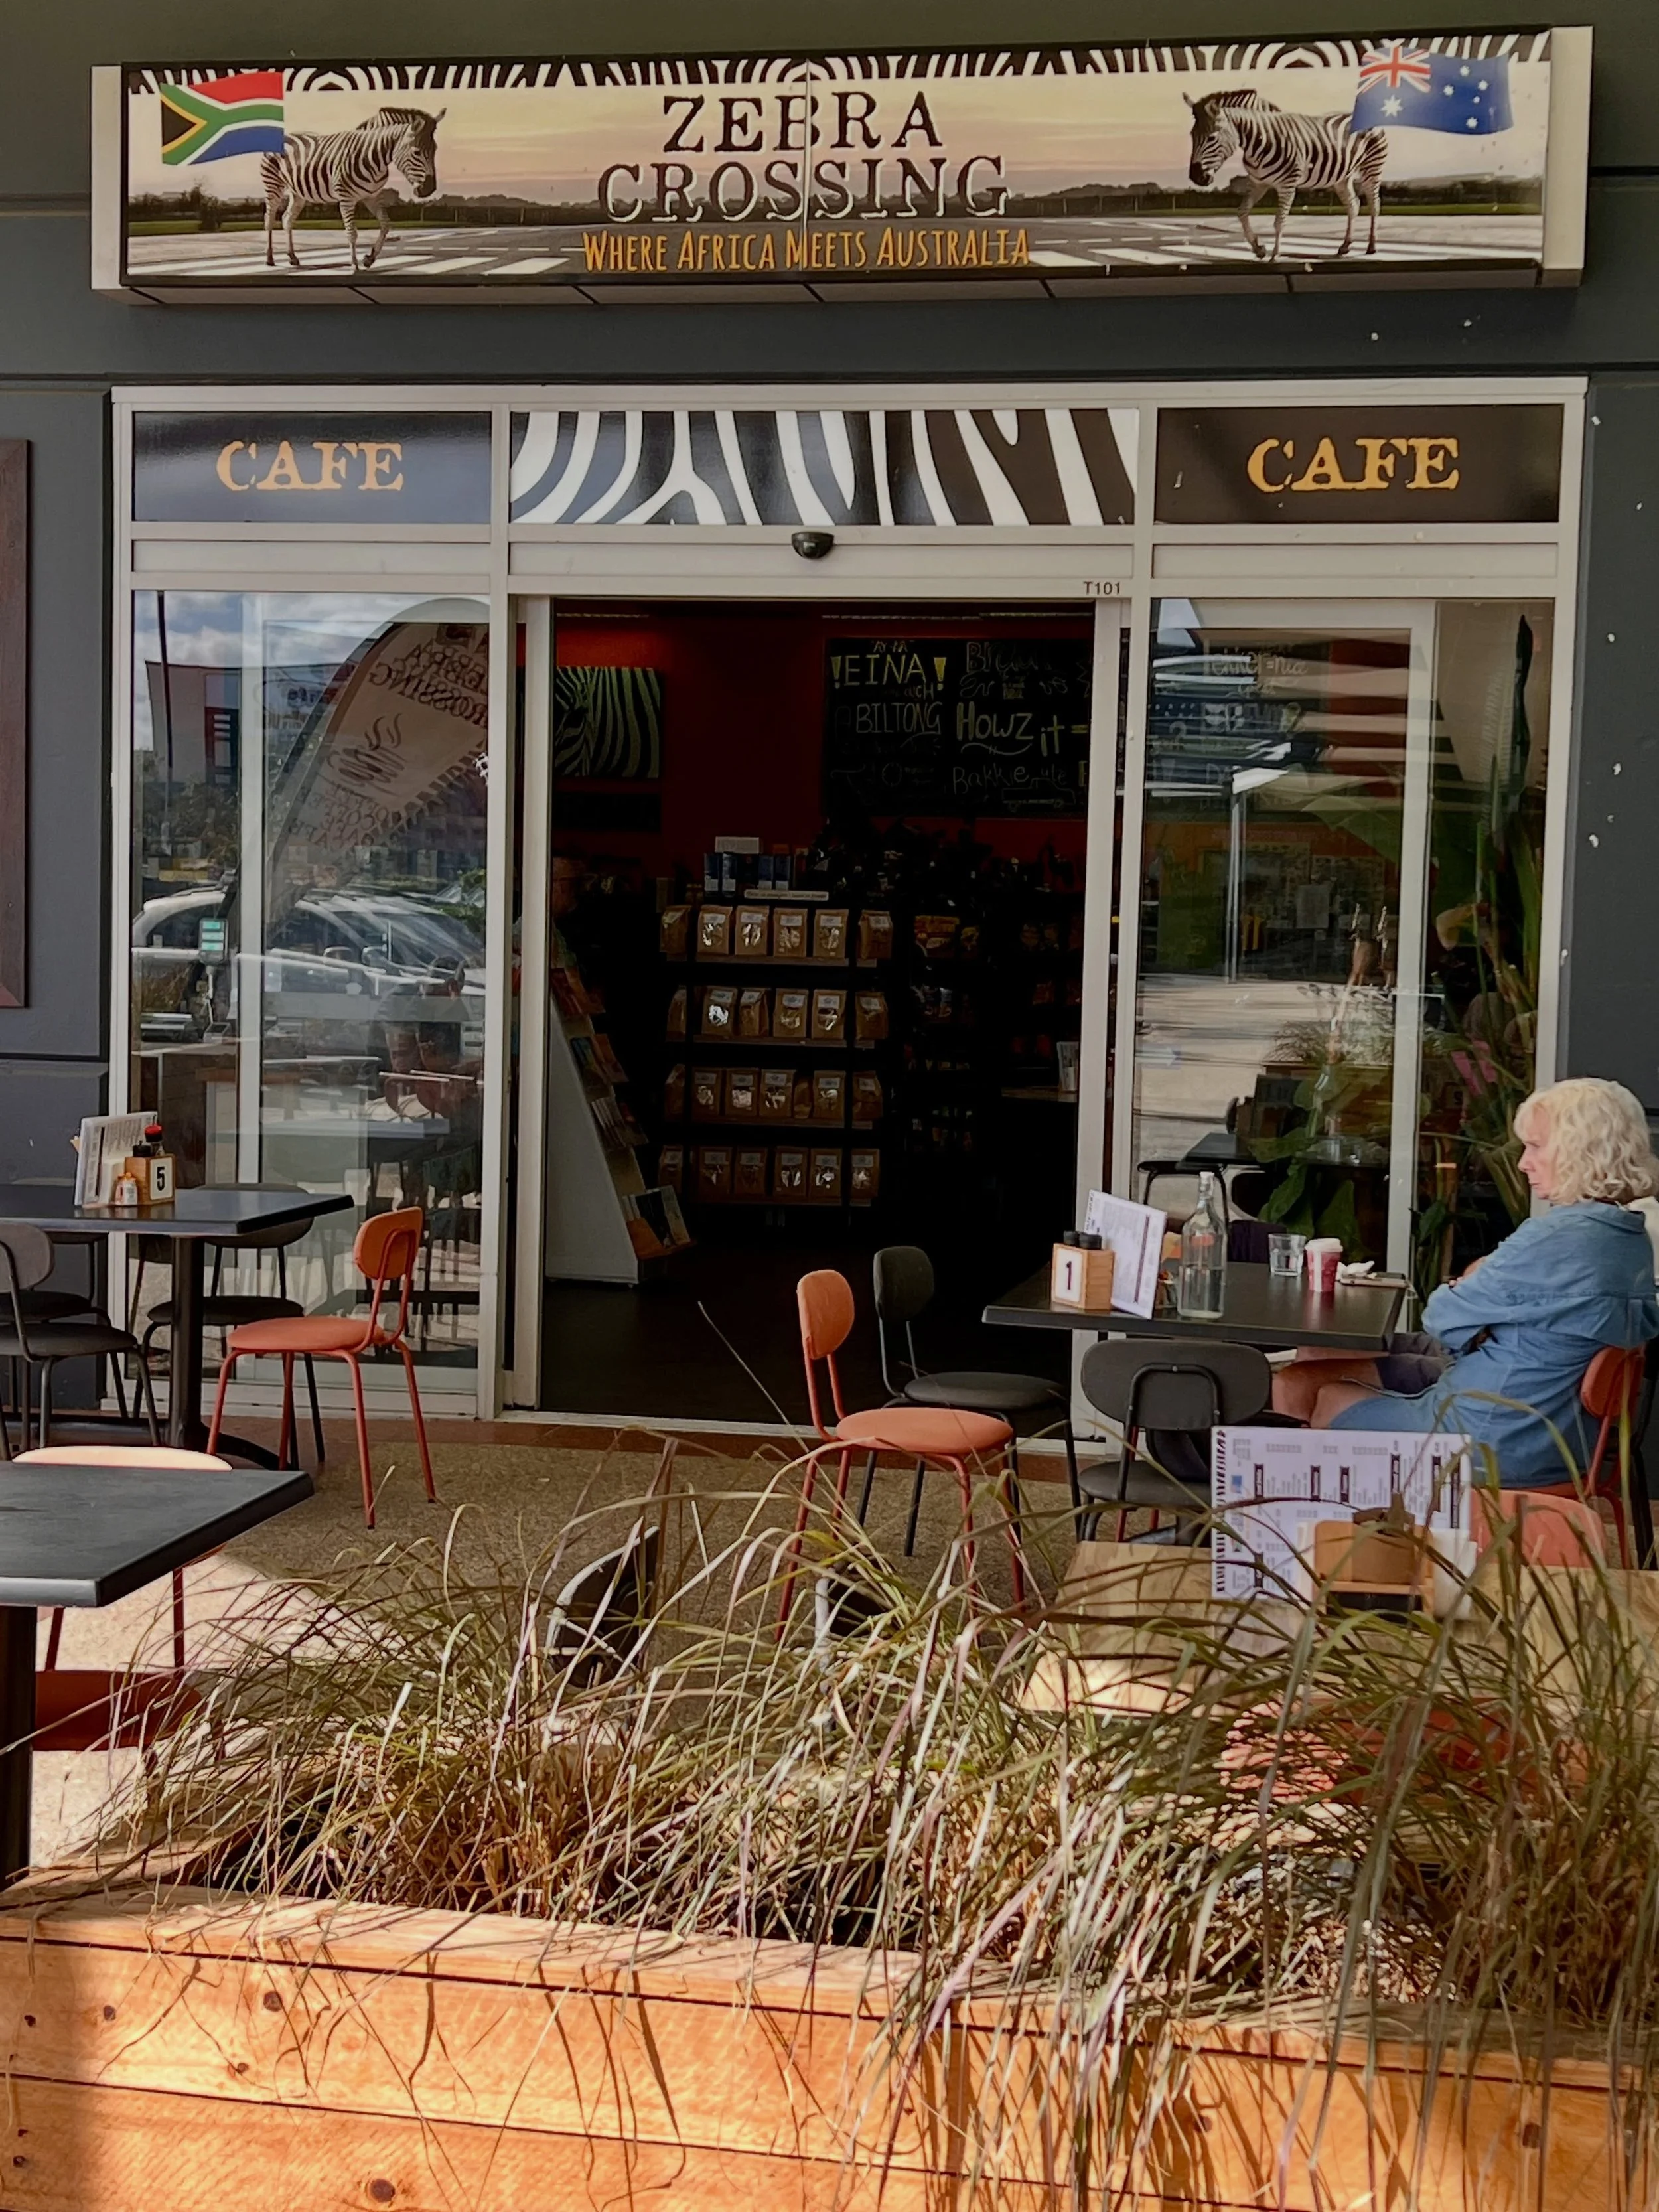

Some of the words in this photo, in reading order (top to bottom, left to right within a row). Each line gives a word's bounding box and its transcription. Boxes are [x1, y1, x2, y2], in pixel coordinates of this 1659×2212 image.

[664, 90, 944, 153] ZEBRA
[597, 155, 1012, 223] CROSSING
[583, 232, 667, 272] WHERE
[678, 230, 774, 271] AFRICA
[786, 228, 867, 270] MEETS
[877, 226, 1031, 267] AUSTRALIA
[216, 440, 404, 491] CAFE
[1246, 437, 1460, 493] CAFE
[1083, 581, 1120, 595] T101
[855, 701, 943, 735] BILTONG
[156, 1166, 166, 1191] 5
[1066, 1260, 1072, 1291] 1
